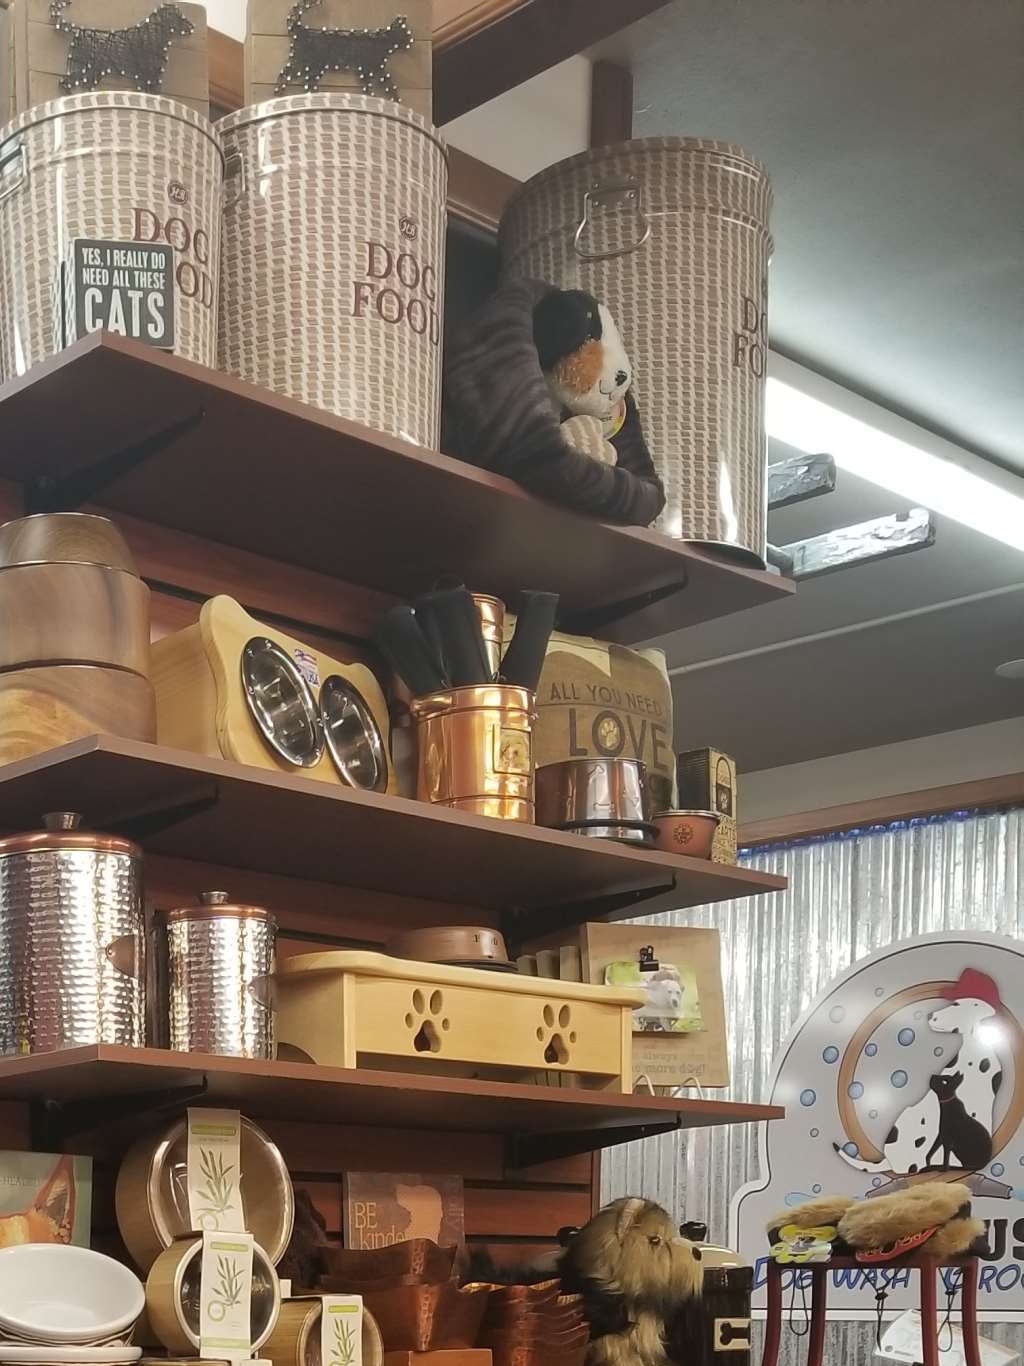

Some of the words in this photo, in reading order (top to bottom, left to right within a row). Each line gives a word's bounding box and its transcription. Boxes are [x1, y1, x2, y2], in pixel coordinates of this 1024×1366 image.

[82, 247, 104, 266] YES,
[106, 249, 111, 262] I
[113, 250, 149, 269] REALLY
[151, 252, 165, 269] DO
[364, 241, 436, 303] DOG
[82, 268, 109, 286] NEED
[112, 269, 130, 287] ALL
[134, 271, 165, 289] THESE
[84, 287, 165, 339] CATS
[352, 281, 439, 346] FOOD
[551, 682, 581, 701] ALL
[586, 685, 622, 705] YOU
[627, 692, 663, 717] NEED
[569, 708, 668, 770] LOVE
[355, 1202, 377, 1229] BE
[832, 1267, 910, 1290] WASH
